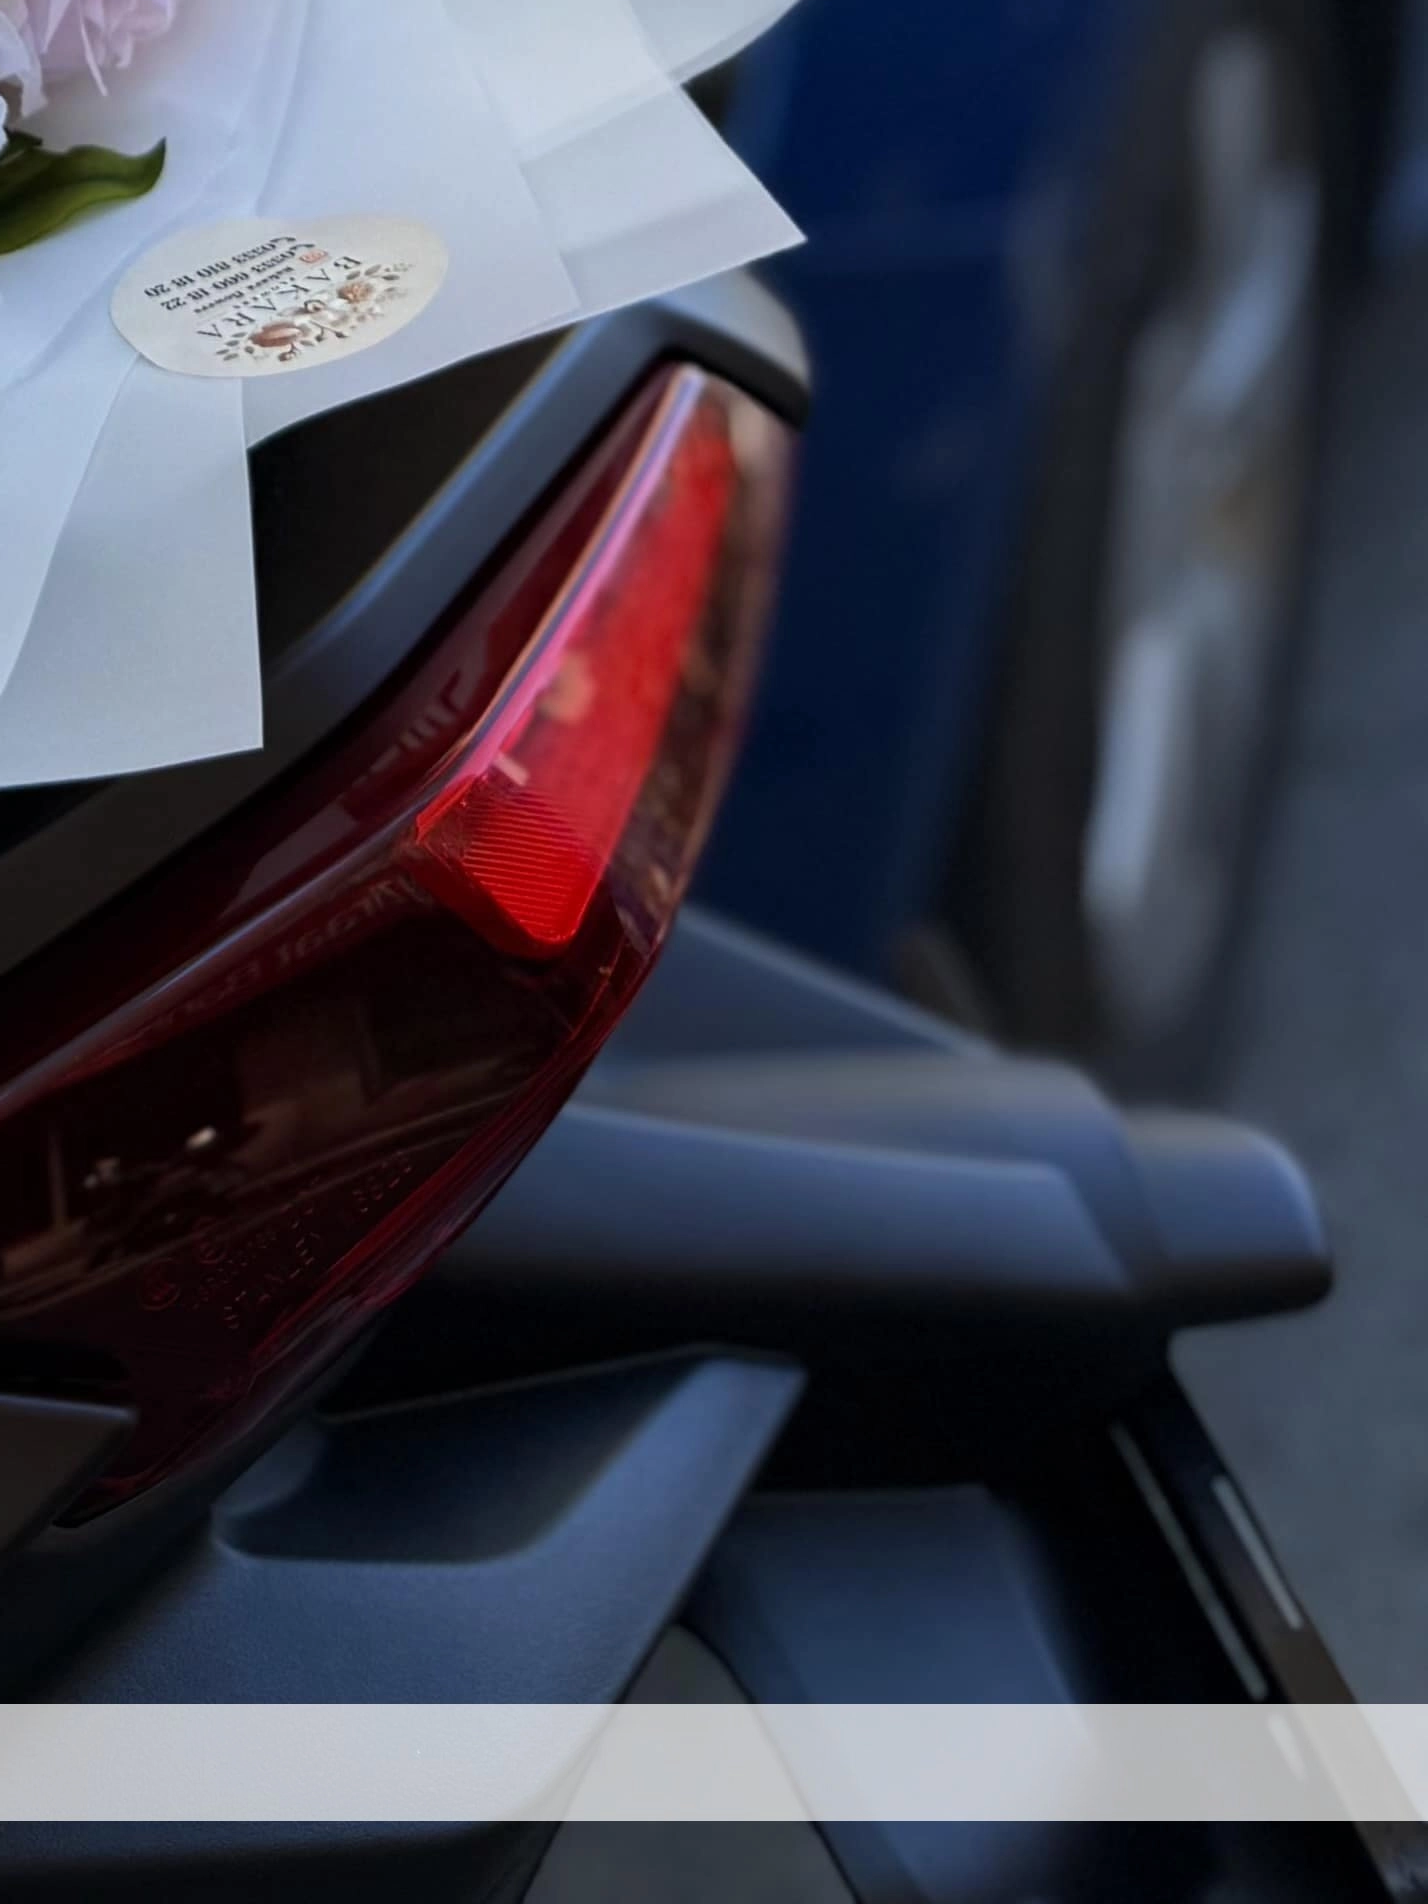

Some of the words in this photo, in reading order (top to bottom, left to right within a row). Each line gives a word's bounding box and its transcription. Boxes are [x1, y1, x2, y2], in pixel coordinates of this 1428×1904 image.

[143, 283, 171, 298] 20
[196, 255, 362, 338] BAKARA
[160, 296, 187, 311] 22
